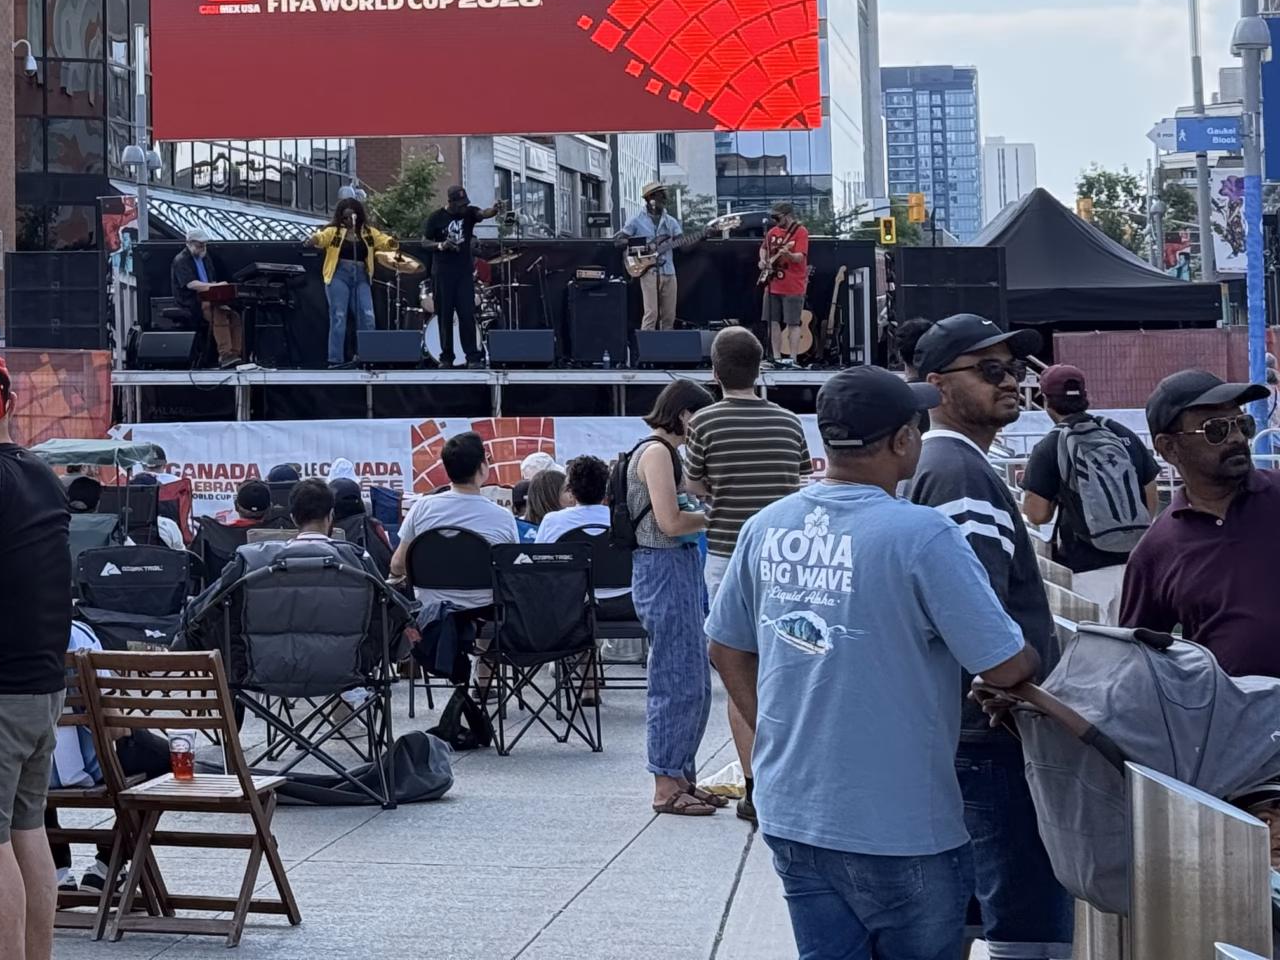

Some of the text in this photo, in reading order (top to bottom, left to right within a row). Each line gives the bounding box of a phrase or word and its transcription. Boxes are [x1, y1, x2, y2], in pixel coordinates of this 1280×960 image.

[241, 3, 261, 13] USA
[1212, 136, 1237, 144] Block
[166, 463, 261, 480] CANADA
[304, 462, 318, 477] LE
[761, 527, 853, 569] KONA
[760, 560, 853, 593] BIG WAVE
[769, 586, 837, 607] Liquid Aloha
